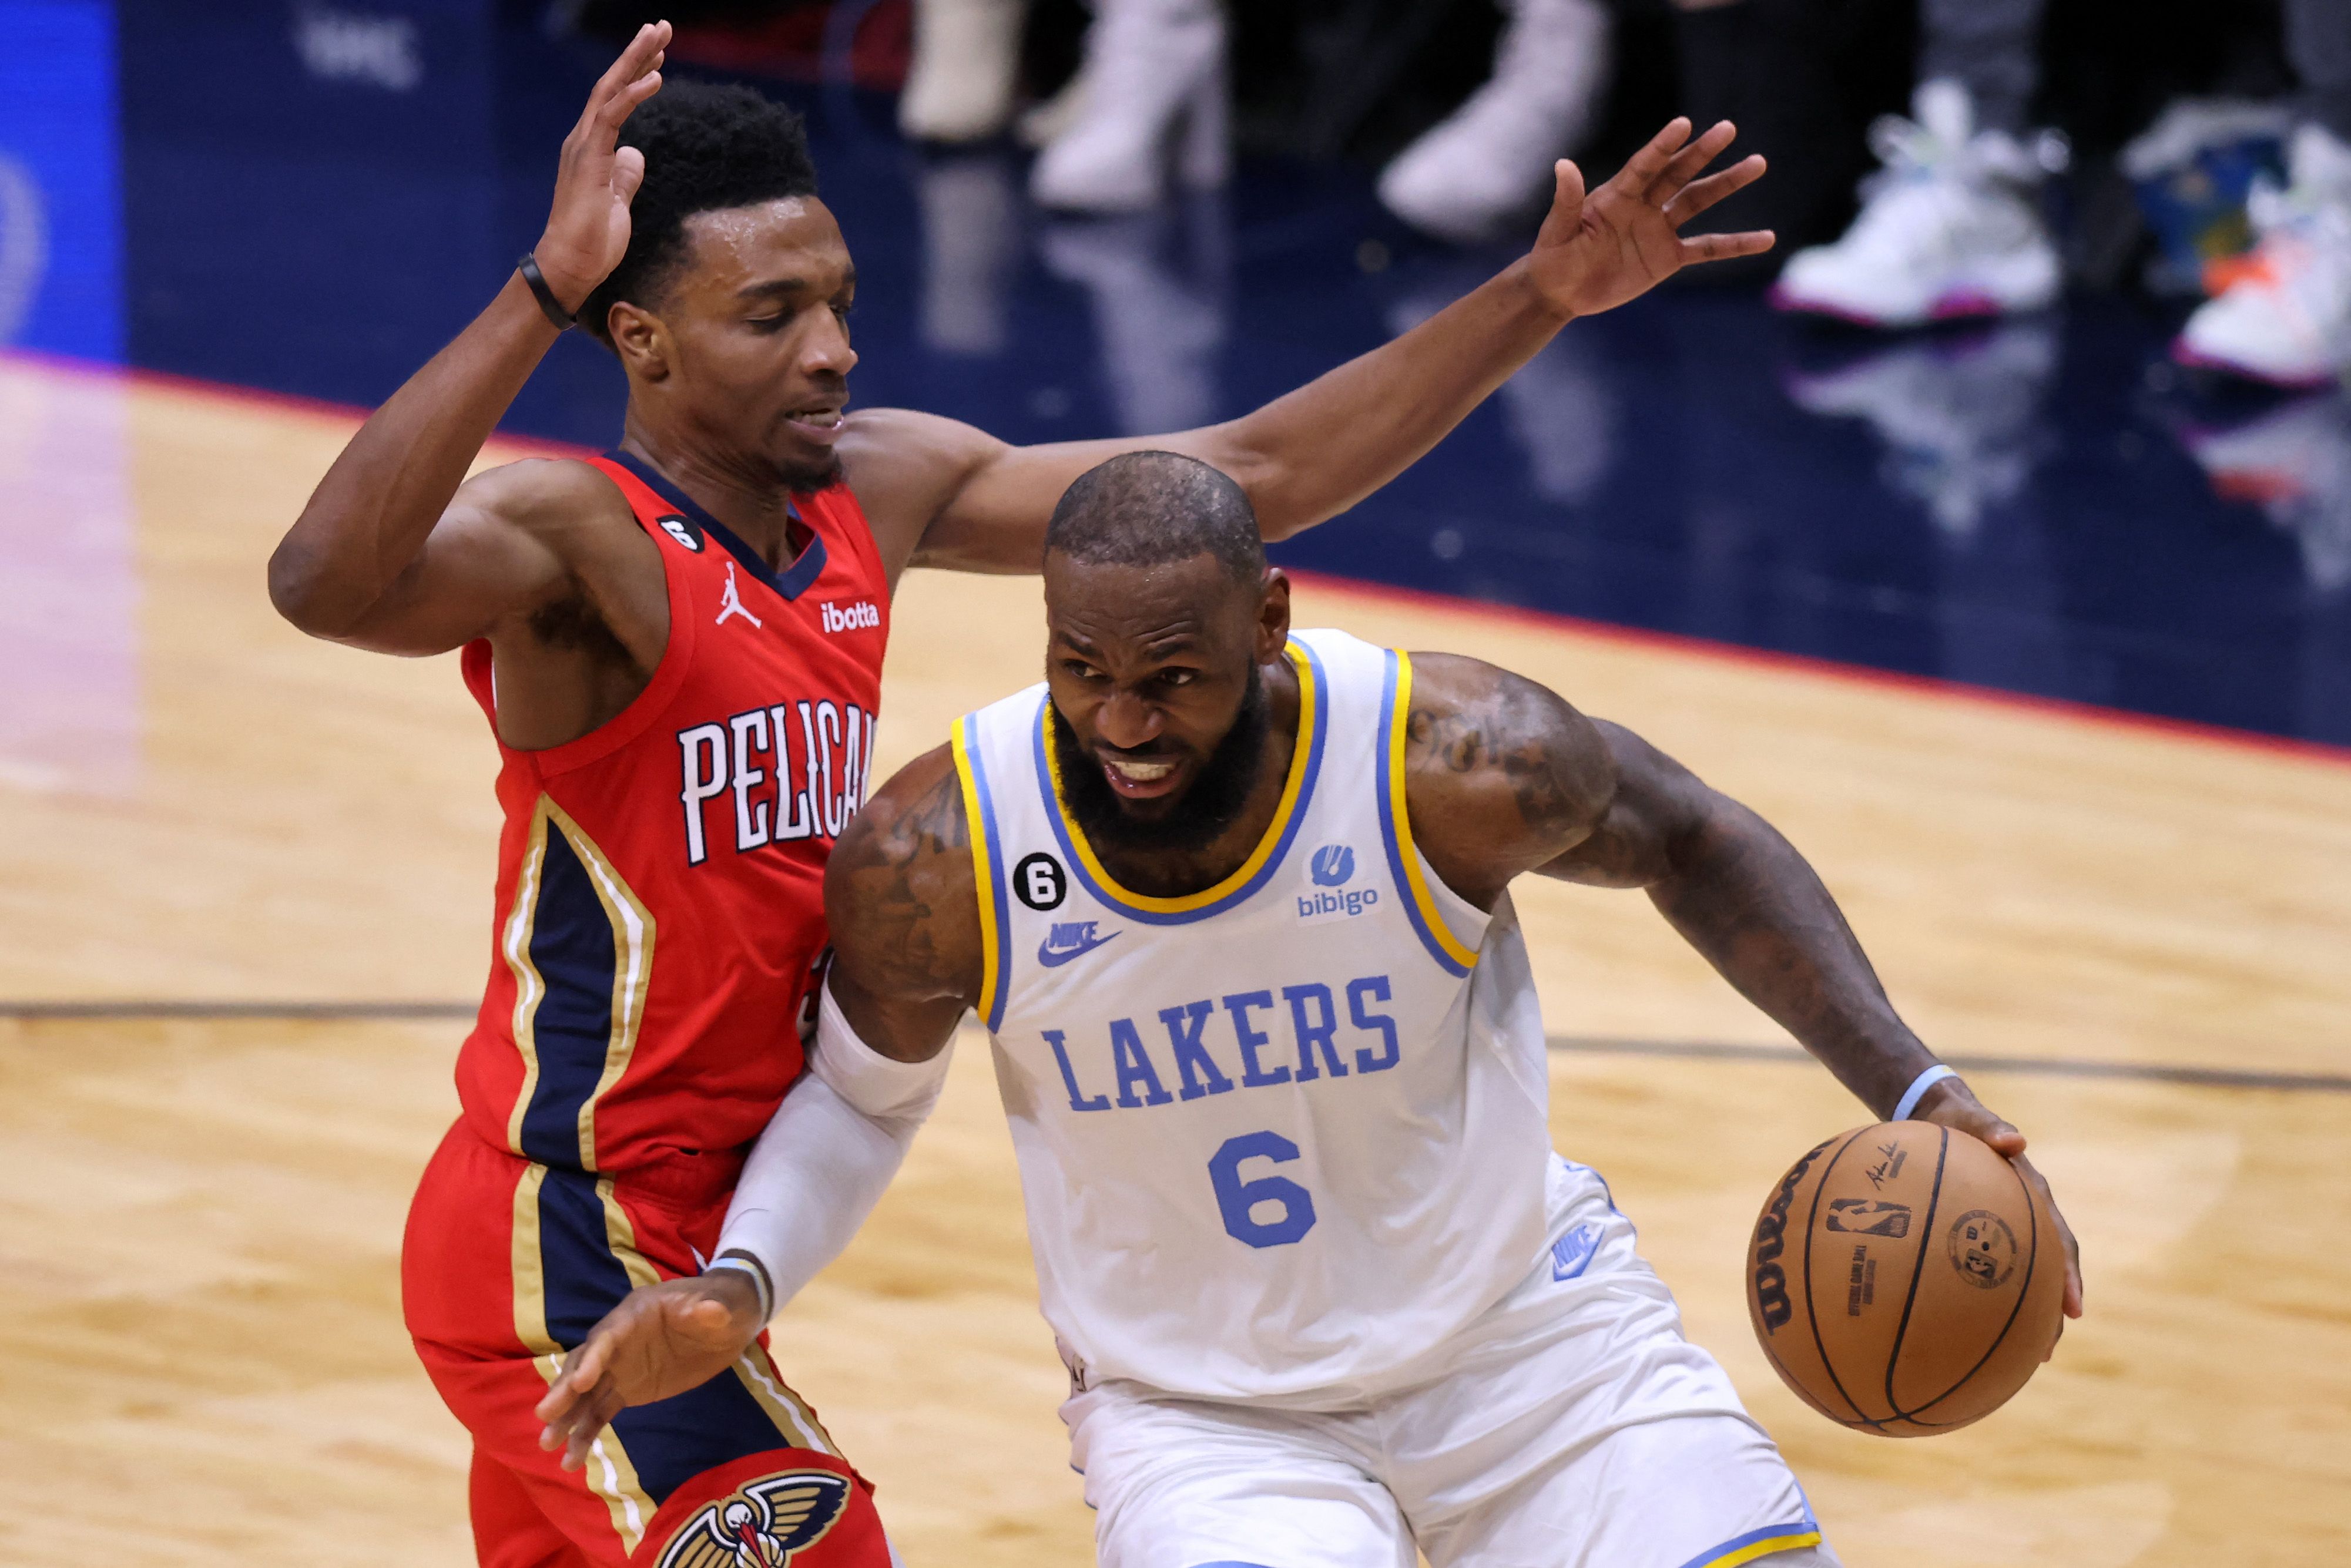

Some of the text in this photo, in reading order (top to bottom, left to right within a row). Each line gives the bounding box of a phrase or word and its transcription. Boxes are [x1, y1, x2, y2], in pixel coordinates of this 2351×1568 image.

[660, 521, 697, 550] 6
[820, 601, 880, 633] ibotta
[1026, 861, 1057, 904] 6
[1297, 889, 1378, 917] bibigo
[1048, 921, 1099, 948] NIKE
[1041, 975, 1400, 1112] LAKERS
[1208, 1130, 1316, 1248] 6
